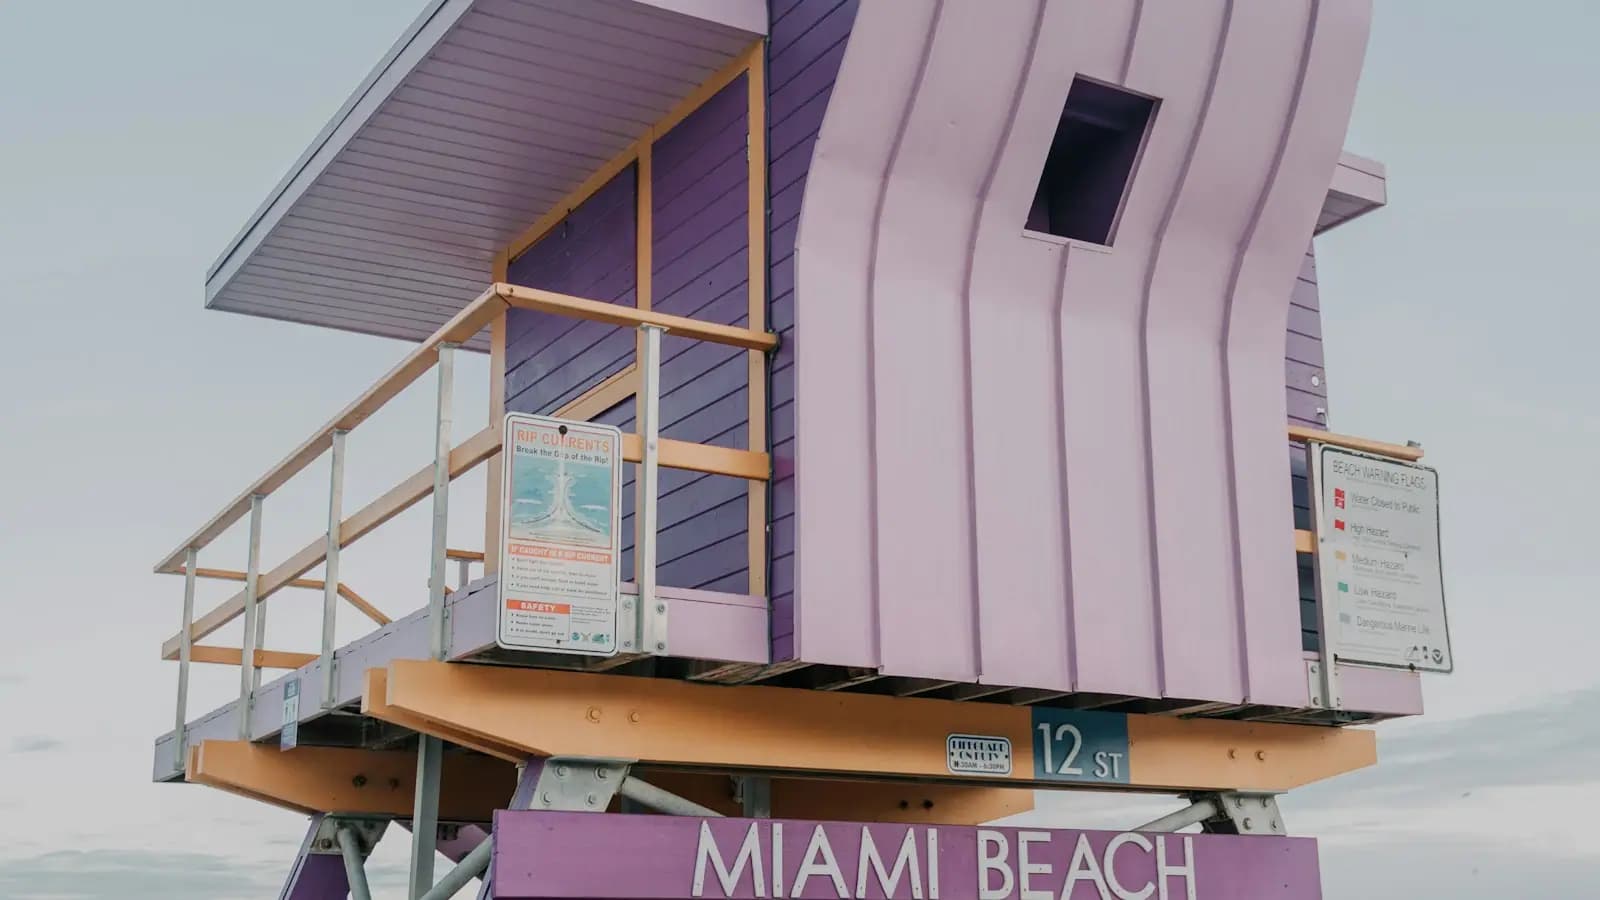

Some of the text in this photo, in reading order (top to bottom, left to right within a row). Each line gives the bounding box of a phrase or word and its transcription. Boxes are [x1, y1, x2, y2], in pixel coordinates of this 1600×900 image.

[516, 445, 538, 454] Break
[554, 450, 569, 460] Gp
[1333, 460, 1360, 475] BEACH
[1363, 466, 1399, 485] WARNING
[1401, 474, 1425, 489] FLAGS
[1351, 491, 1369, 505] Water
[1371, 496, 1393, 509] Closed
[520, 602, 556, 612] SAFETY
[1037, 723, 1123, 778] 12 ST
[692, 820, 1197, 900] MIAMI BEACH
